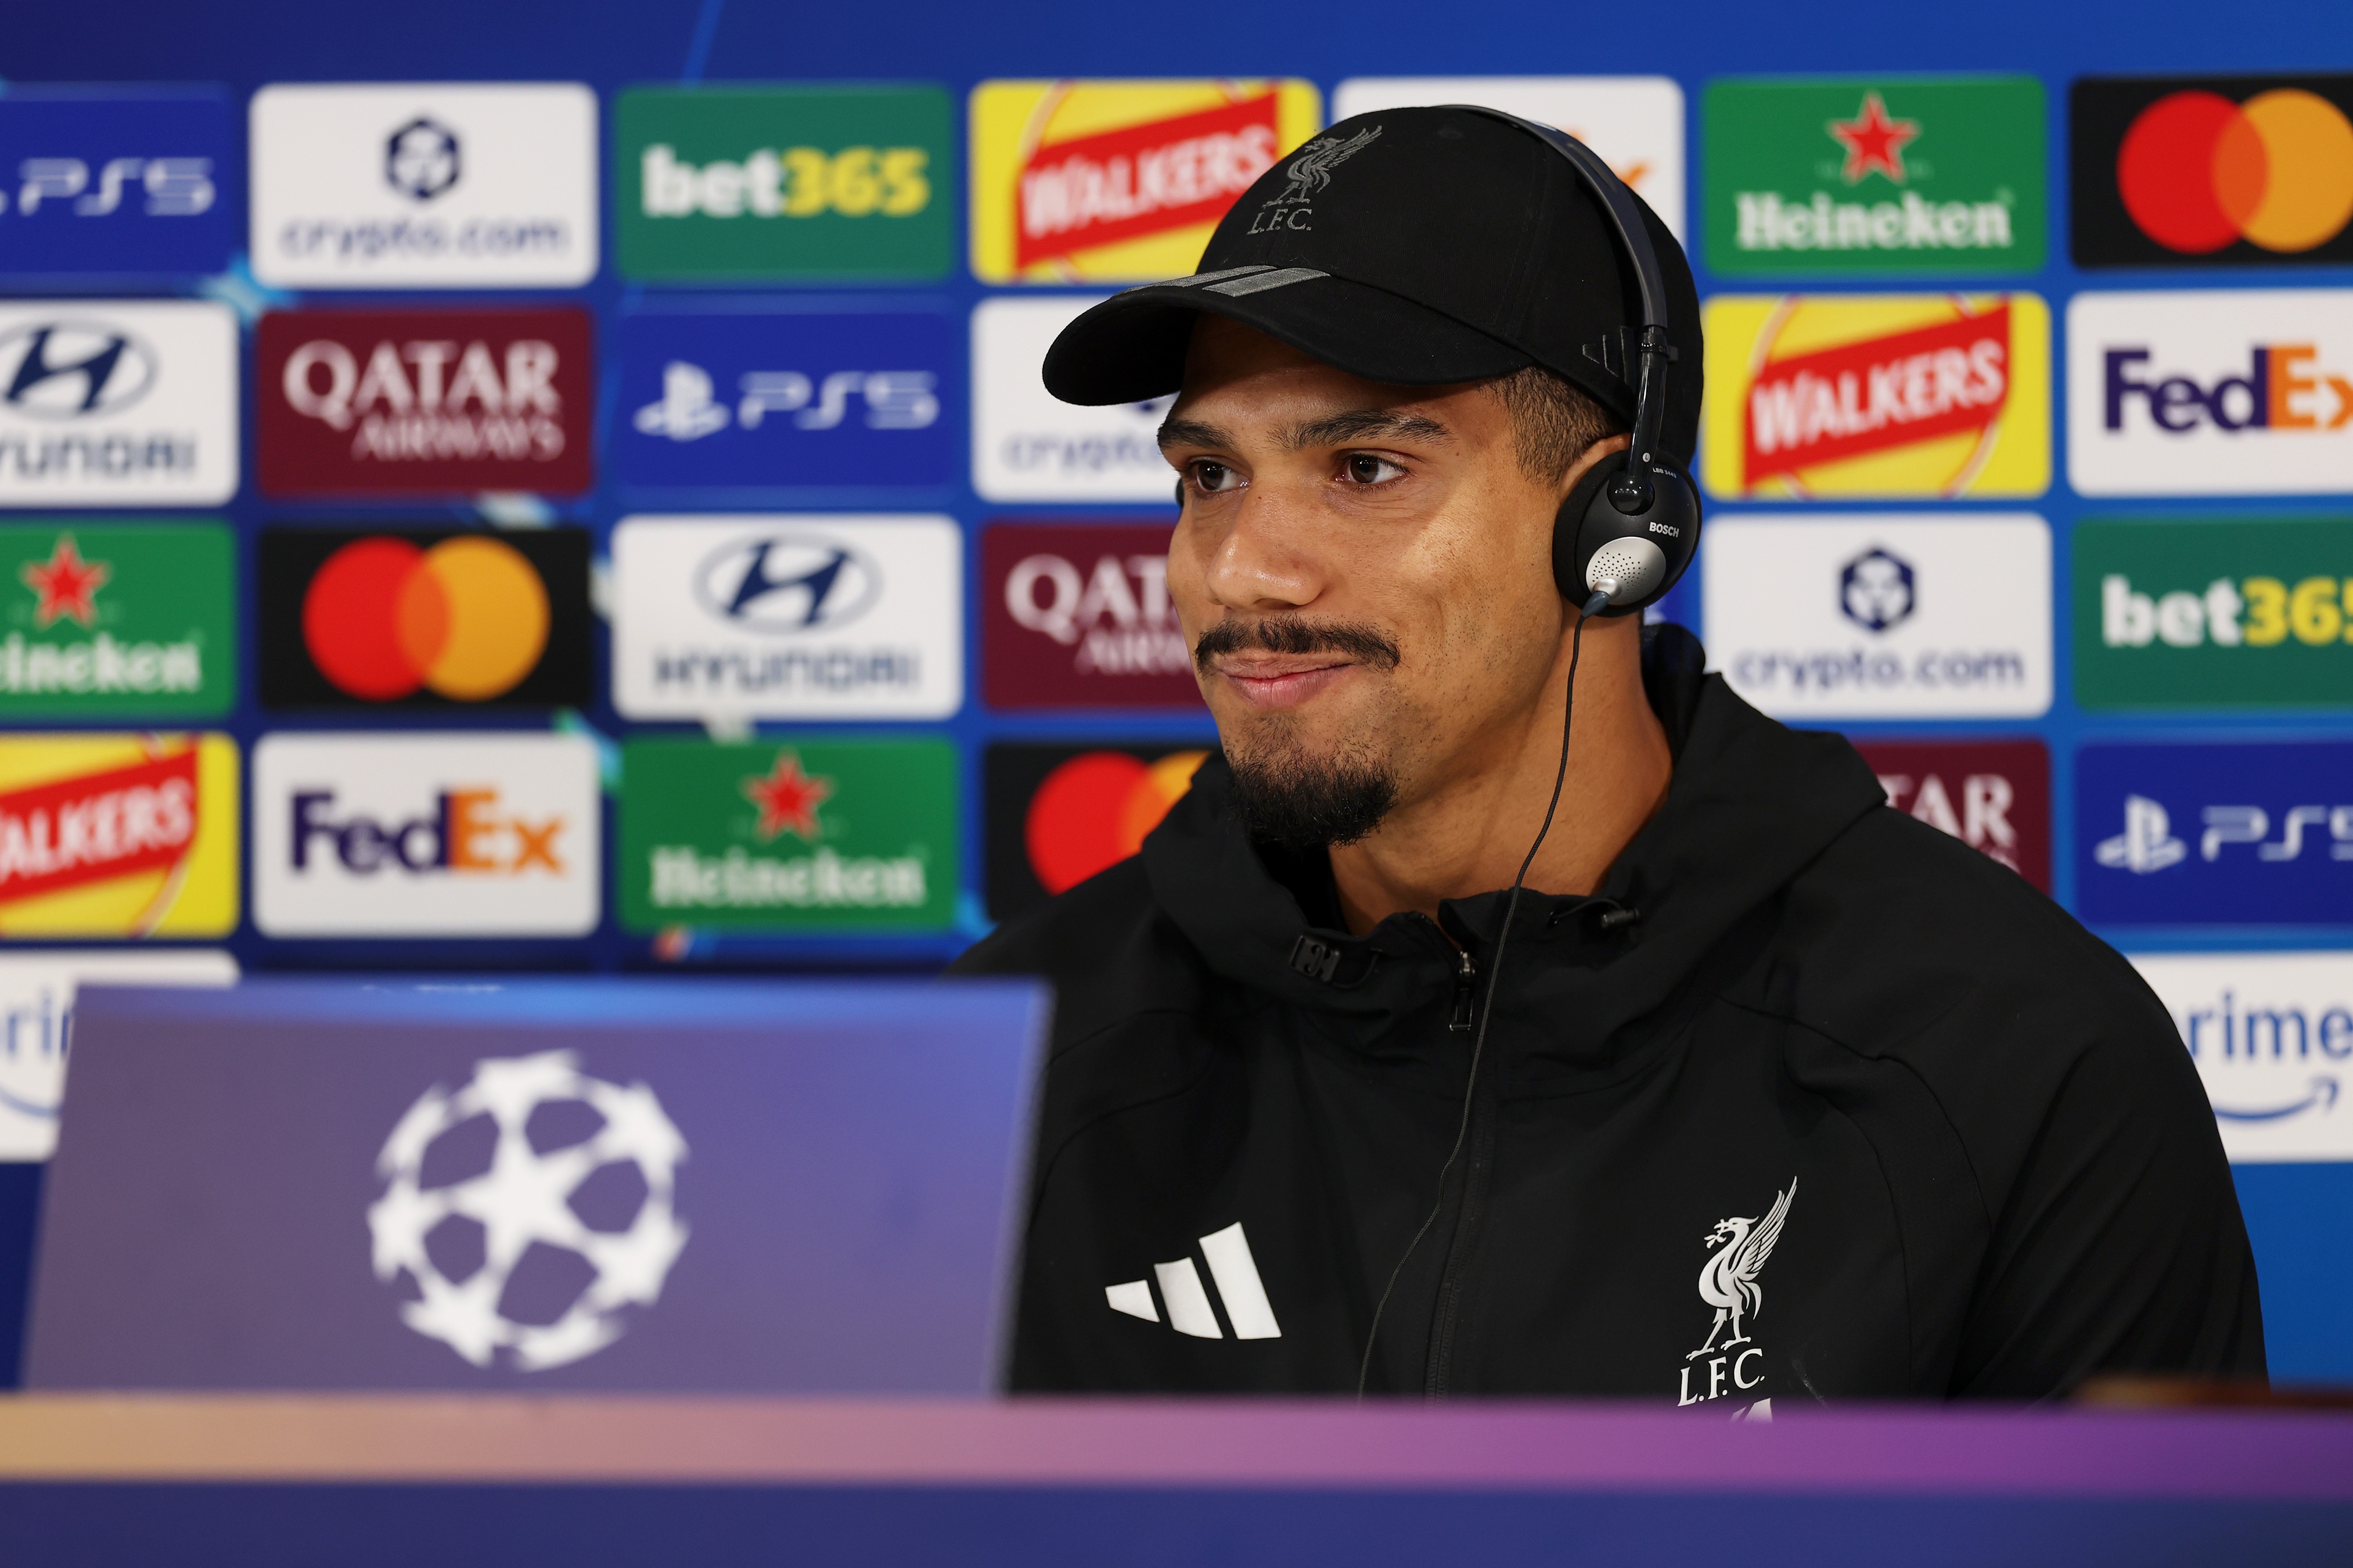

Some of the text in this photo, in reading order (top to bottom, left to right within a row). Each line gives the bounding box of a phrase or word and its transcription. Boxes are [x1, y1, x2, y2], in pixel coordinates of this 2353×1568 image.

[17, 157, 217, 215] PS5
[641, 143, 931, 218] bet365
[1022, 124, 1277, 239] WALKERS
[277, 213, 572, 267] crypto.com
[1246, 208, 1312, 235] L.F.C.
[1735, 190, 2013, 251] Heineken
[282, 340, 561, 430] QATAR
[737, 371, 941, 430] PS5
[1750, 338, 2004, 455] WALKERS
[351, 411, 565, 461] AIRWAYS
[1649, 521, 1679, 538] BOSCH
[1004, 553, 1176, 646] QAT
[2101, 574, 2353, 648] bet36
[0, 630, 202, 693] ineken
[649, 645, 920, 692] HYUNDAI
[1732, 642, 2027, 691] crypto.com
[0, 776, 193, 885] ALKERS
[286, 785, 564, 875] FedEx
[2200, 805, 2353, 861] PS
[649, 846, 927, 907] Heineken
[2186, 987, 2353, 1062] rime
[1677, 1348, 1765, 1407] L.F.C.
